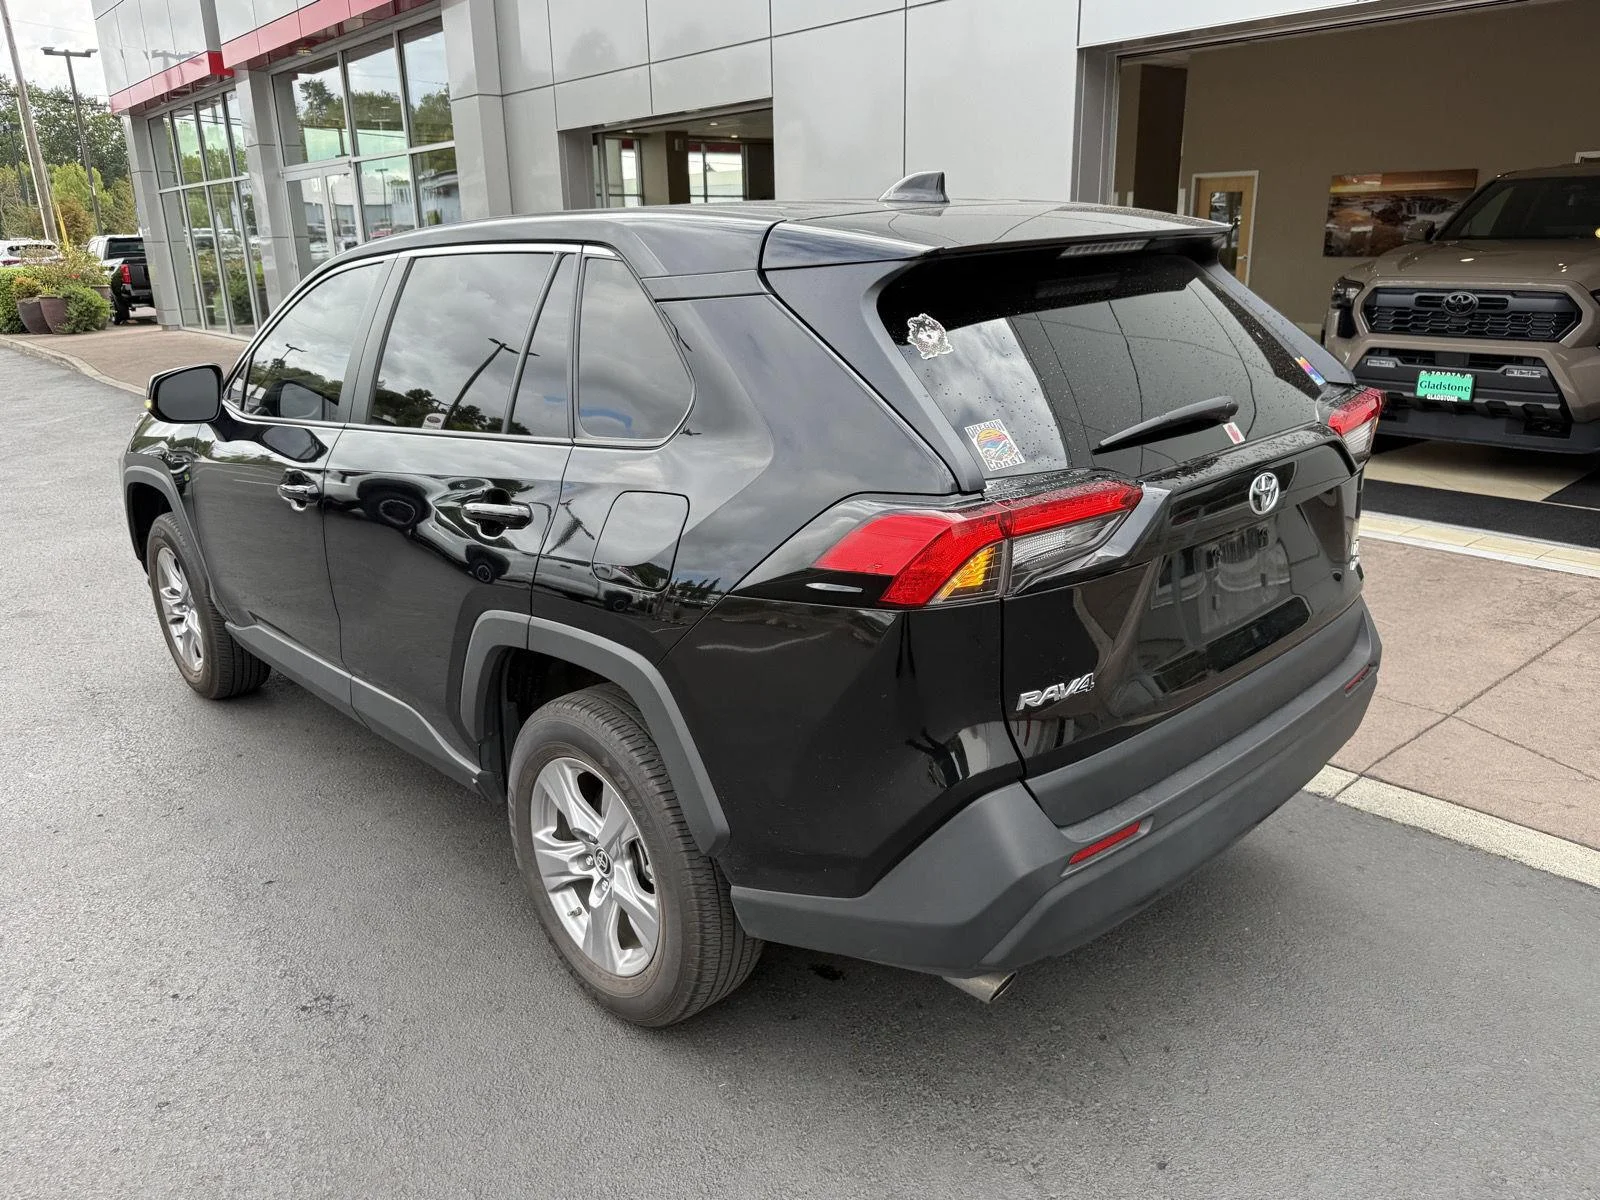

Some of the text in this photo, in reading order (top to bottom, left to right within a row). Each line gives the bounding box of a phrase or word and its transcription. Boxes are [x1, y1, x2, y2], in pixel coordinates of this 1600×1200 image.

[1419, 380, 1471, 393] Gladstone
[1426, 393, 1458, 402] GLADSTONE
[966, 420, 1005, 439] OREGON
[1016, 672, 1095, 711] RAV4
